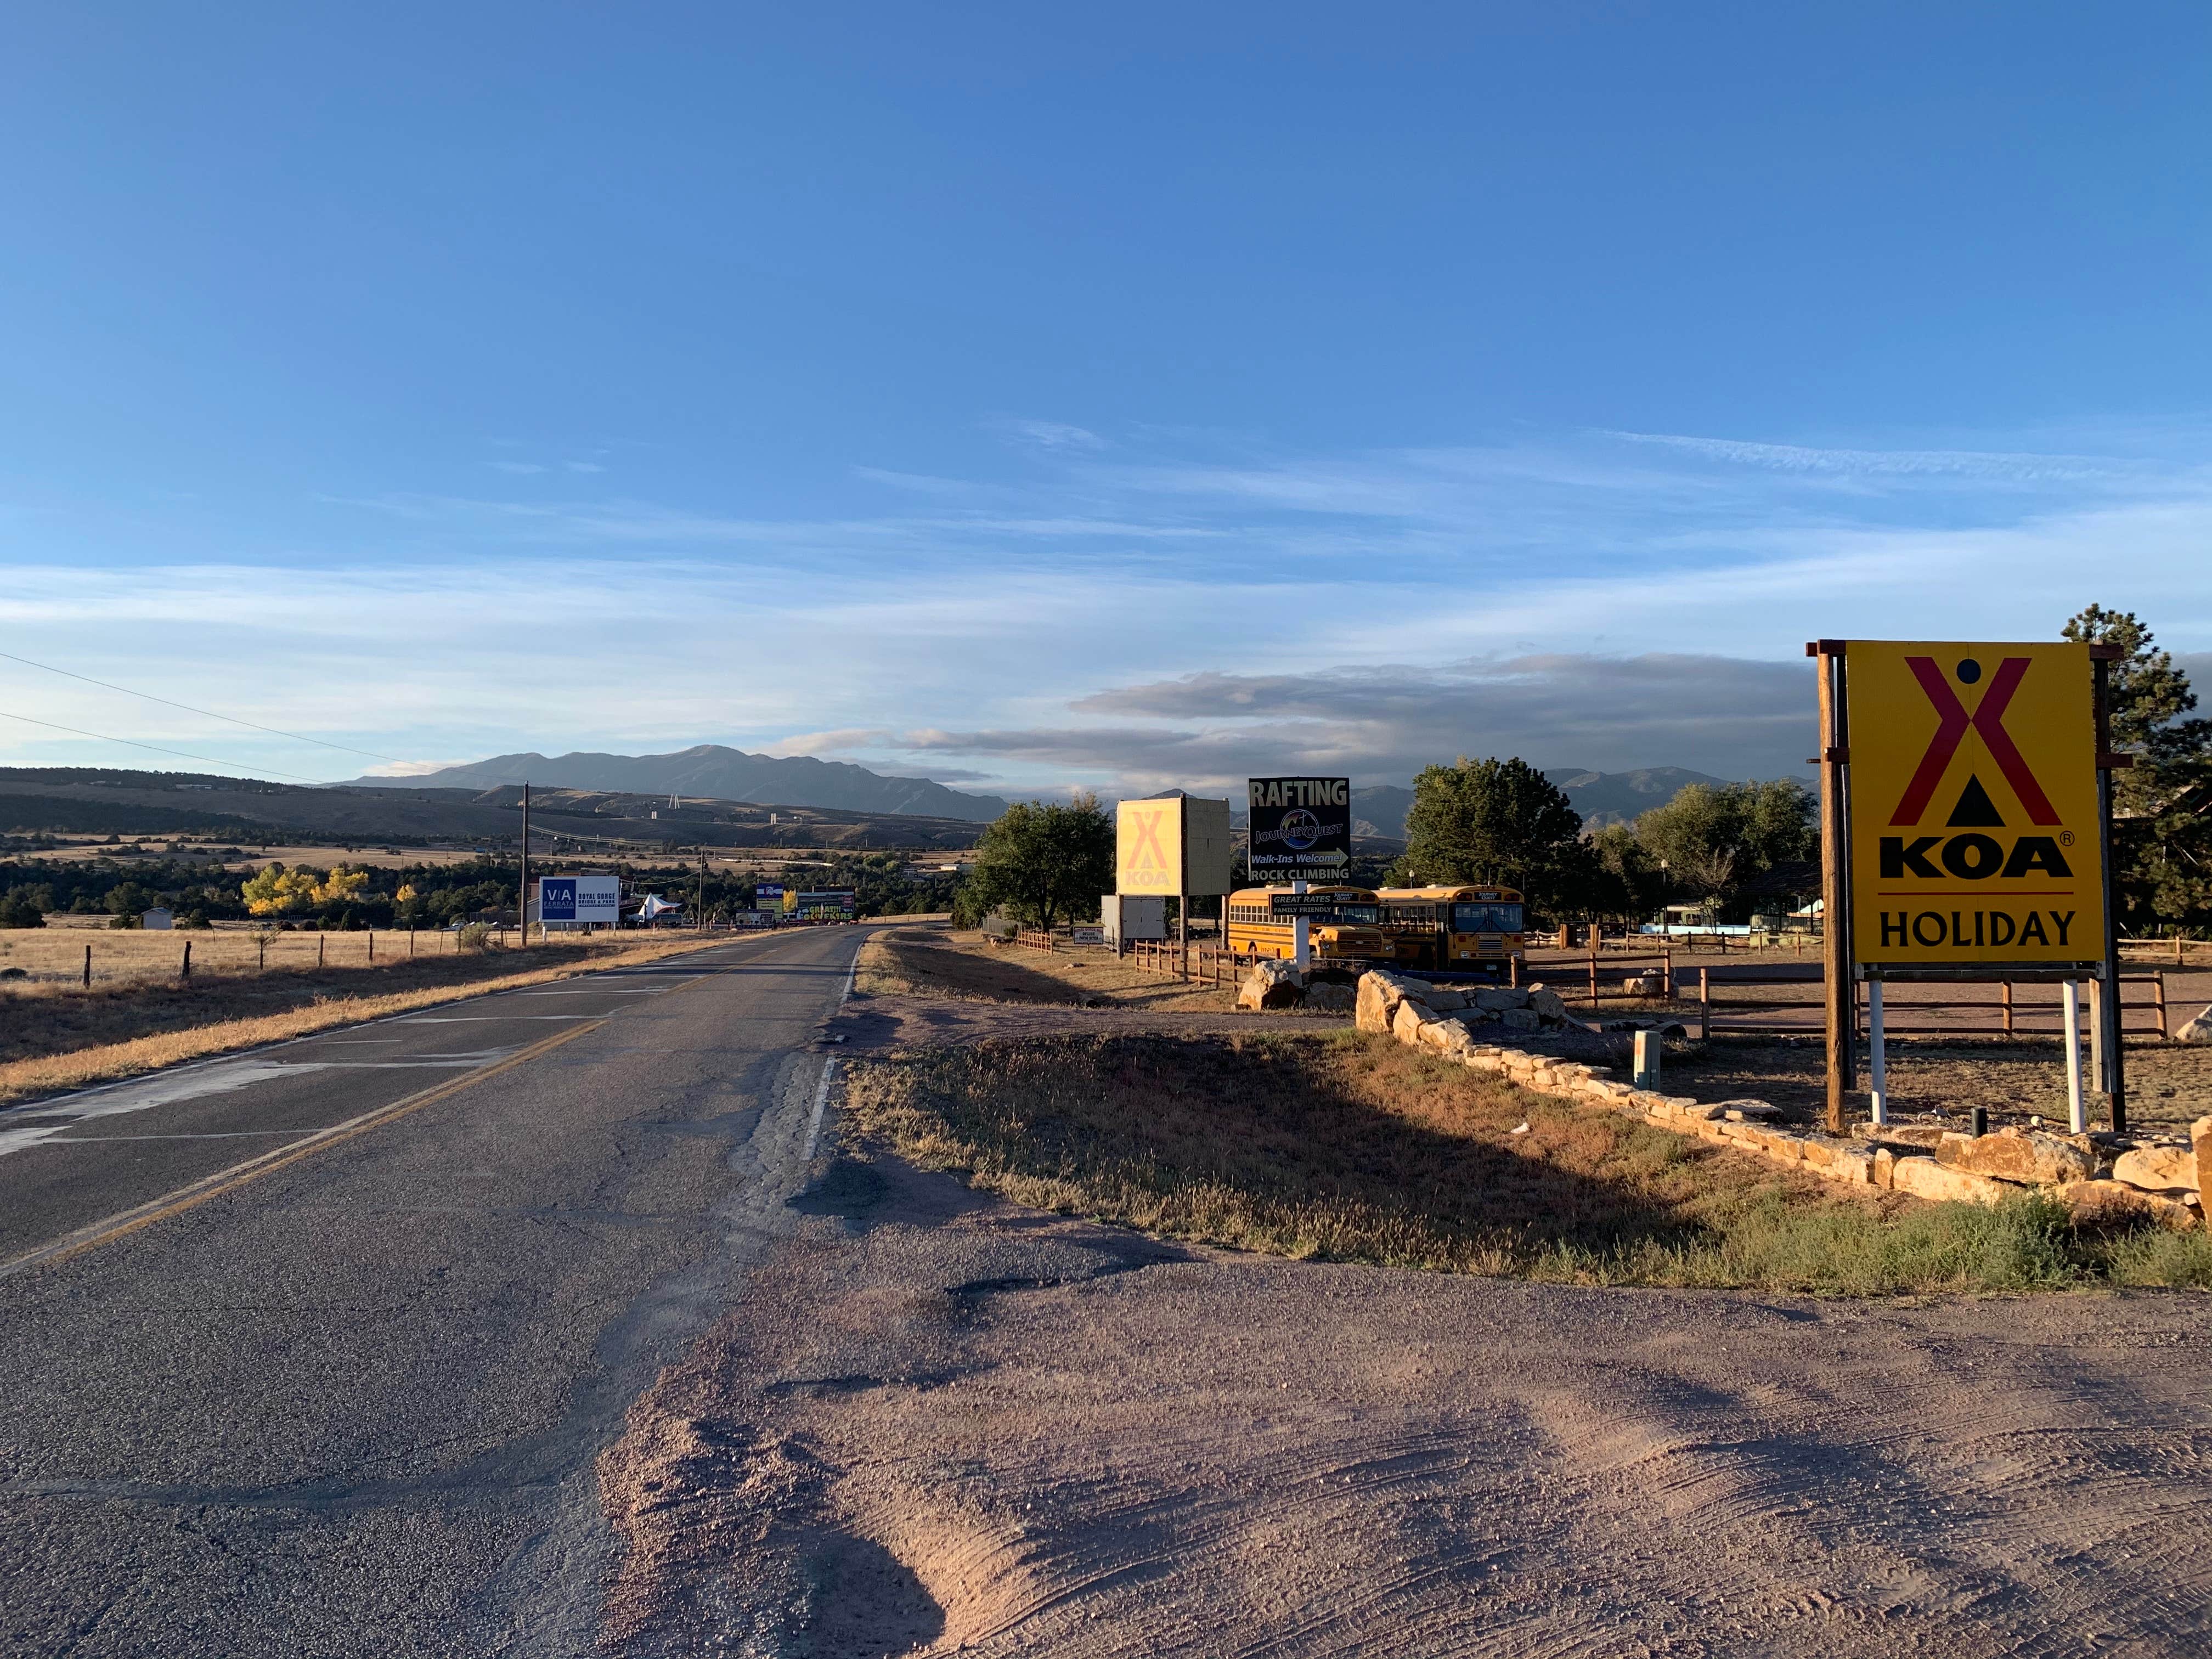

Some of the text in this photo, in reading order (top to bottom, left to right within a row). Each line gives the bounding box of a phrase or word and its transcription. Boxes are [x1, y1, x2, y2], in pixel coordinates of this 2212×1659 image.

[1250, 780, 1347, 807] RAFTING
[1251, 854, 1342, 864] Walk-Ins Welcome!
[1125, 871, 1171, 887] KOA
[1251, 868, 1350, 881] ROCK CLIMBING
[548, 889, 571, 901] VIA
[1880, 910, 2076, 947] HOLIDAY
